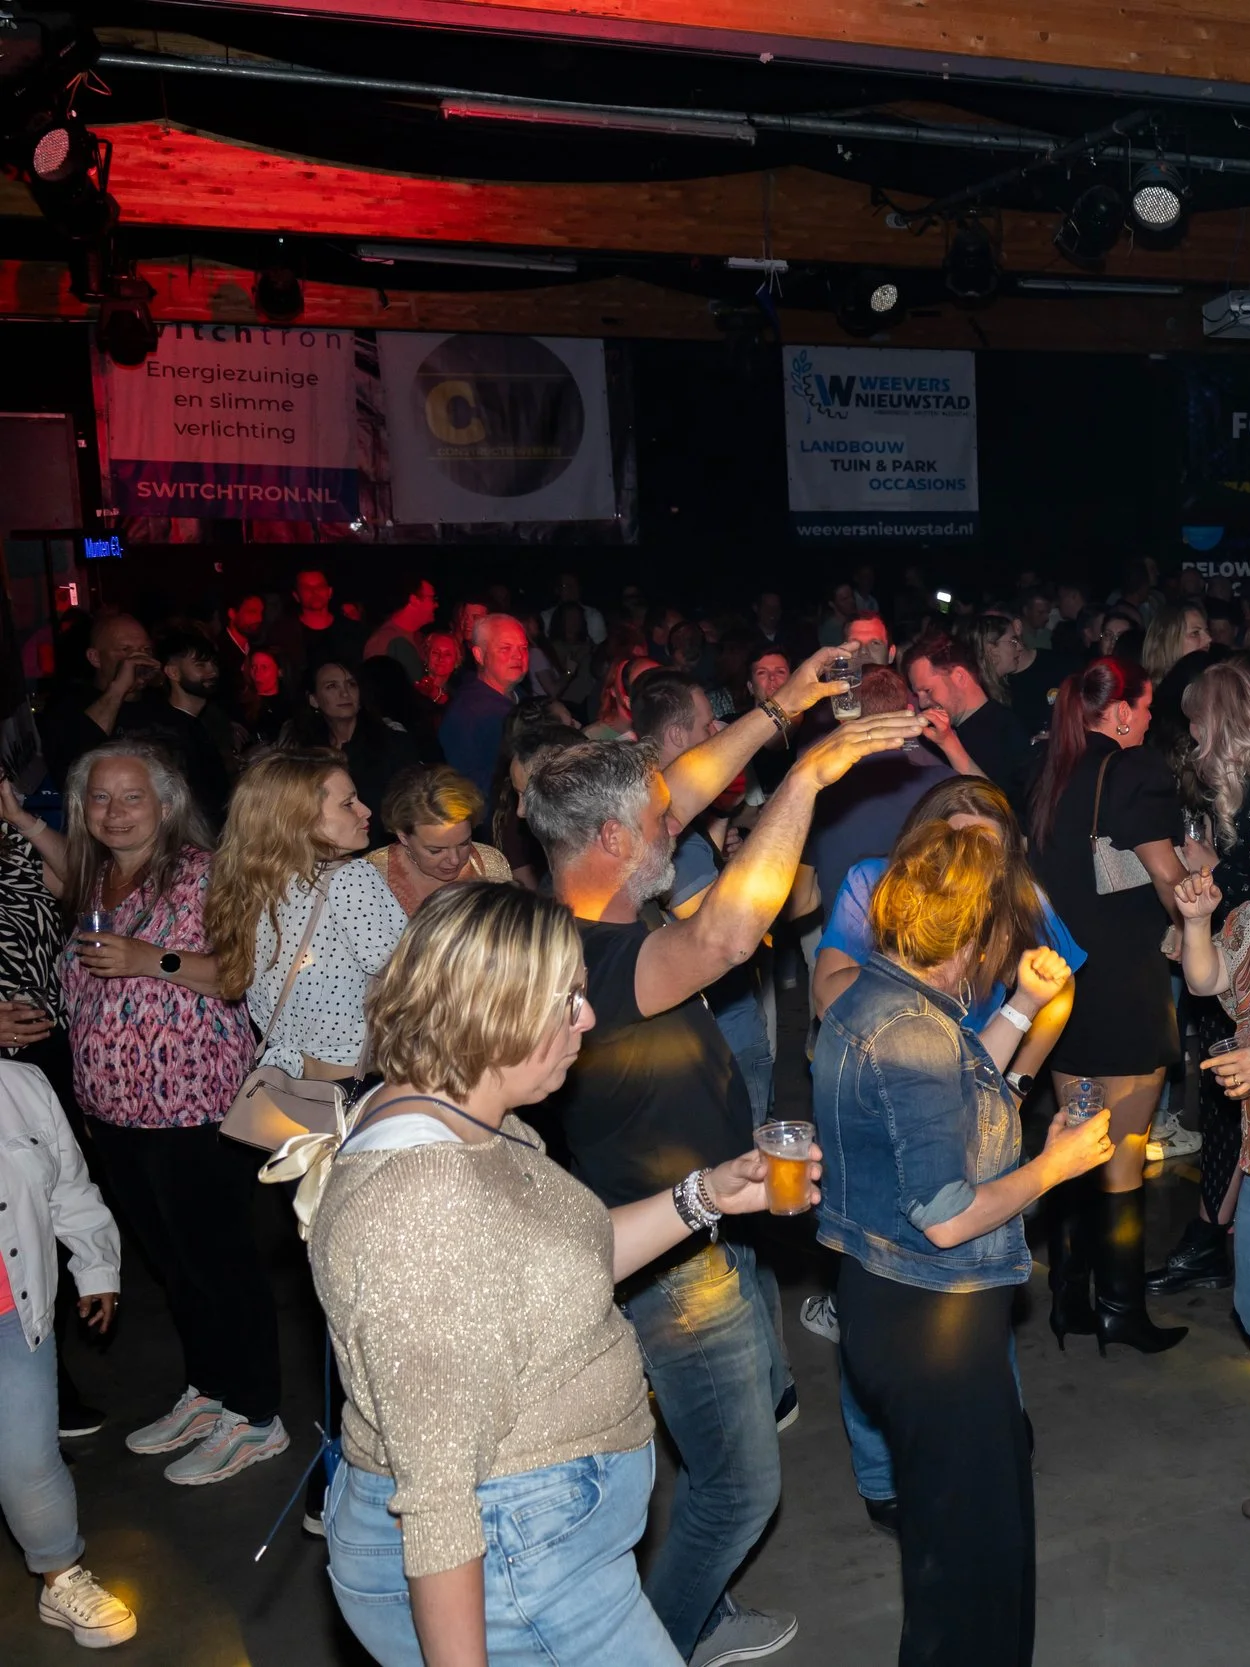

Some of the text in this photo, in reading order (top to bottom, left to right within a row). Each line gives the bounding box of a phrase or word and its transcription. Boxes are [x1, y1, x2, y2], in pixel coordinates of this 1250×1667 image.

[156, 324, 342, 350] itchtron
[146, 361, 320, 388] Energiezuinige
[860, 376, 950, 392] WEEVERS
[174, 393, 295, 412] en slimme
[855, 393, 971, 410] NIEUWSTAD
[174, 420, 296, 444] verlichting
[800, 440, 905, 454] LANDBOUW
[831, 459, 937, 473] TUIN & PARK
[137, 481, 337, 504] SWITCHTRON.NL
[869, 478, 966, 491] OCCASIONS
[796, 521, 974, 537] weeversnieuwstad.nl
